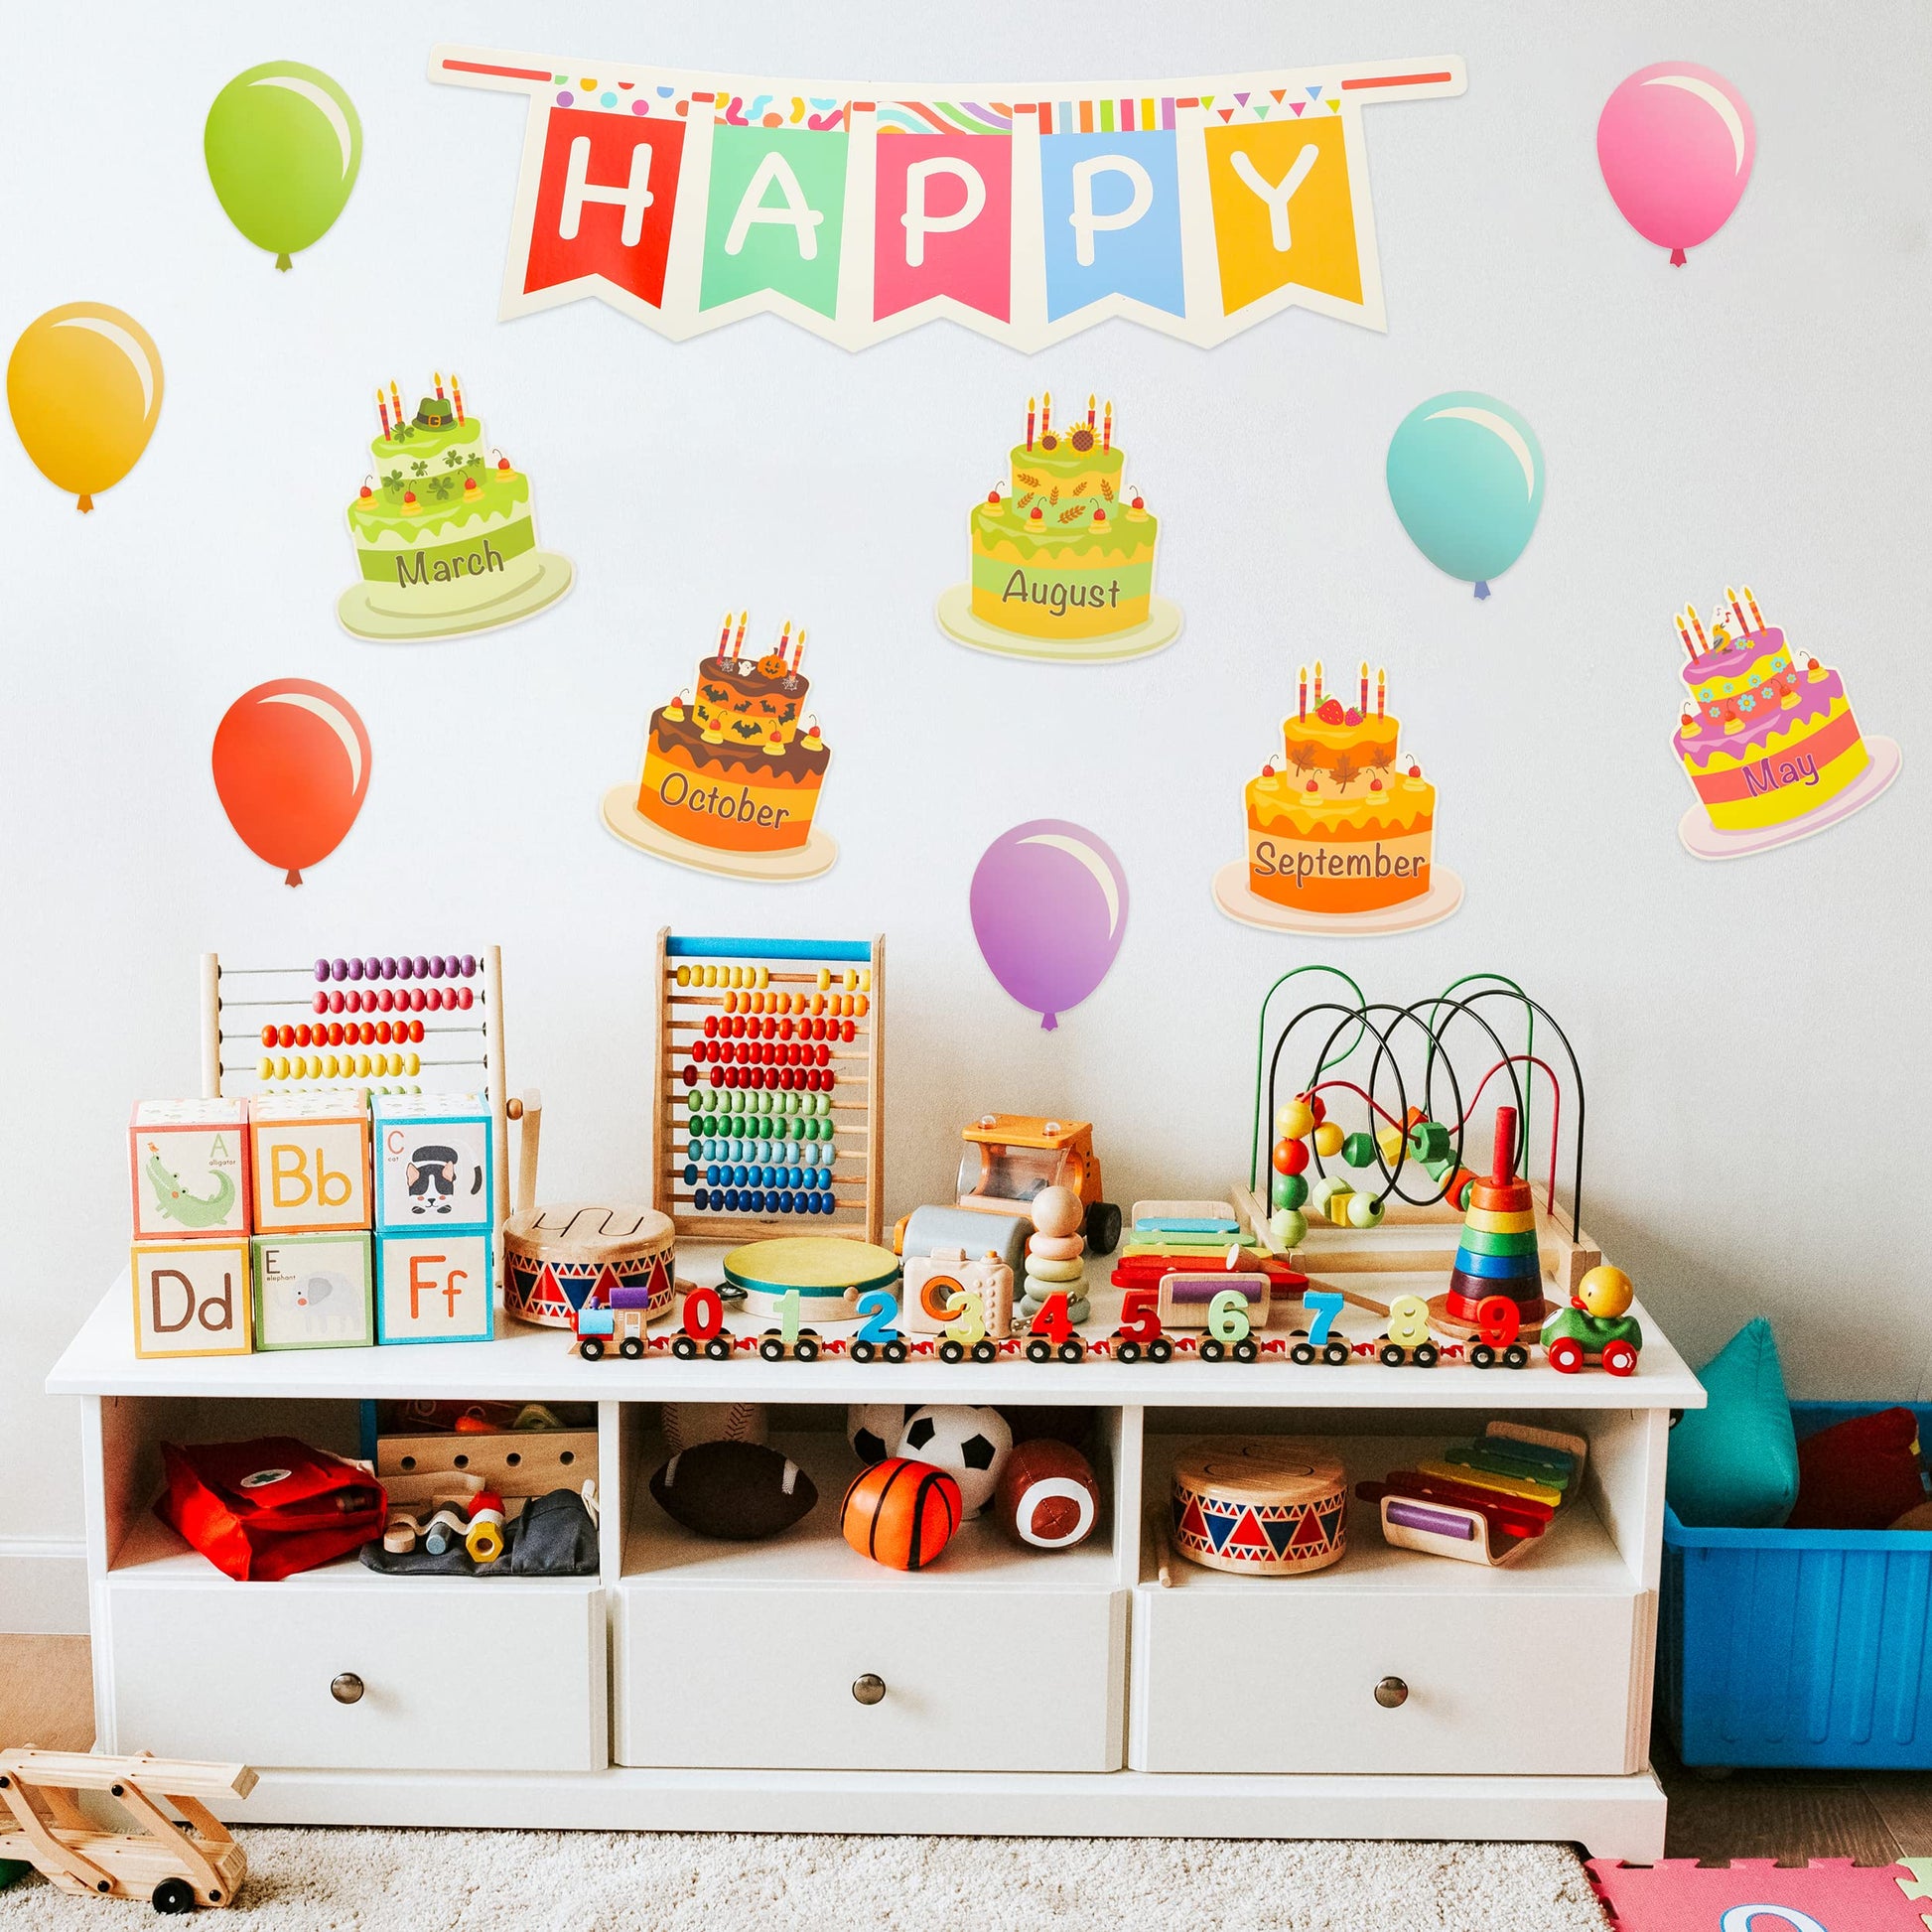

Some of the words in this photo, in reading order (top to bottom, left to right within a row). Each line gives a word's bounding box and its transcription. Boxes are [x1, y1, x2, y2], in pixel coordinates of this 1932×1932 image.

[558, 135, 1319, 267] HAPPY
[395, 539, 504, 589] March
[1002, 569, 1121, 617] August
[660, 771, 790, 829] October
[1741, 754, 1820, 797] May
[1254, 841, 1426, 888] September
[208, 1159, 236, 1168] alligator
[209, 1132, 229, 1158] A
[387, 1130, 405, 1155] C
[271, 1144, 352, 1208] Bb
[265, 1250, 281, 1274] E
[151, 1269, 232, 1333] Dd
[409, 1255, 468, 1319] Ff
[683, 1288, 723, 1339] 0
[772, 1290, 800, 1341] 1
[856, 1291, 898, 1343] 2
[945, 1291, 986, 1342] 3
[1032, 1292, 1073, 1342] 4
[1119, 1291, 1162, 1342] 5
[1208, 1291, 1251, 1342] 6
[1303, 1292, 1345, 1344] 7
[1388, 1295, 1430, 1347] 8
[1478, 1296, 1520, 1347] 9
